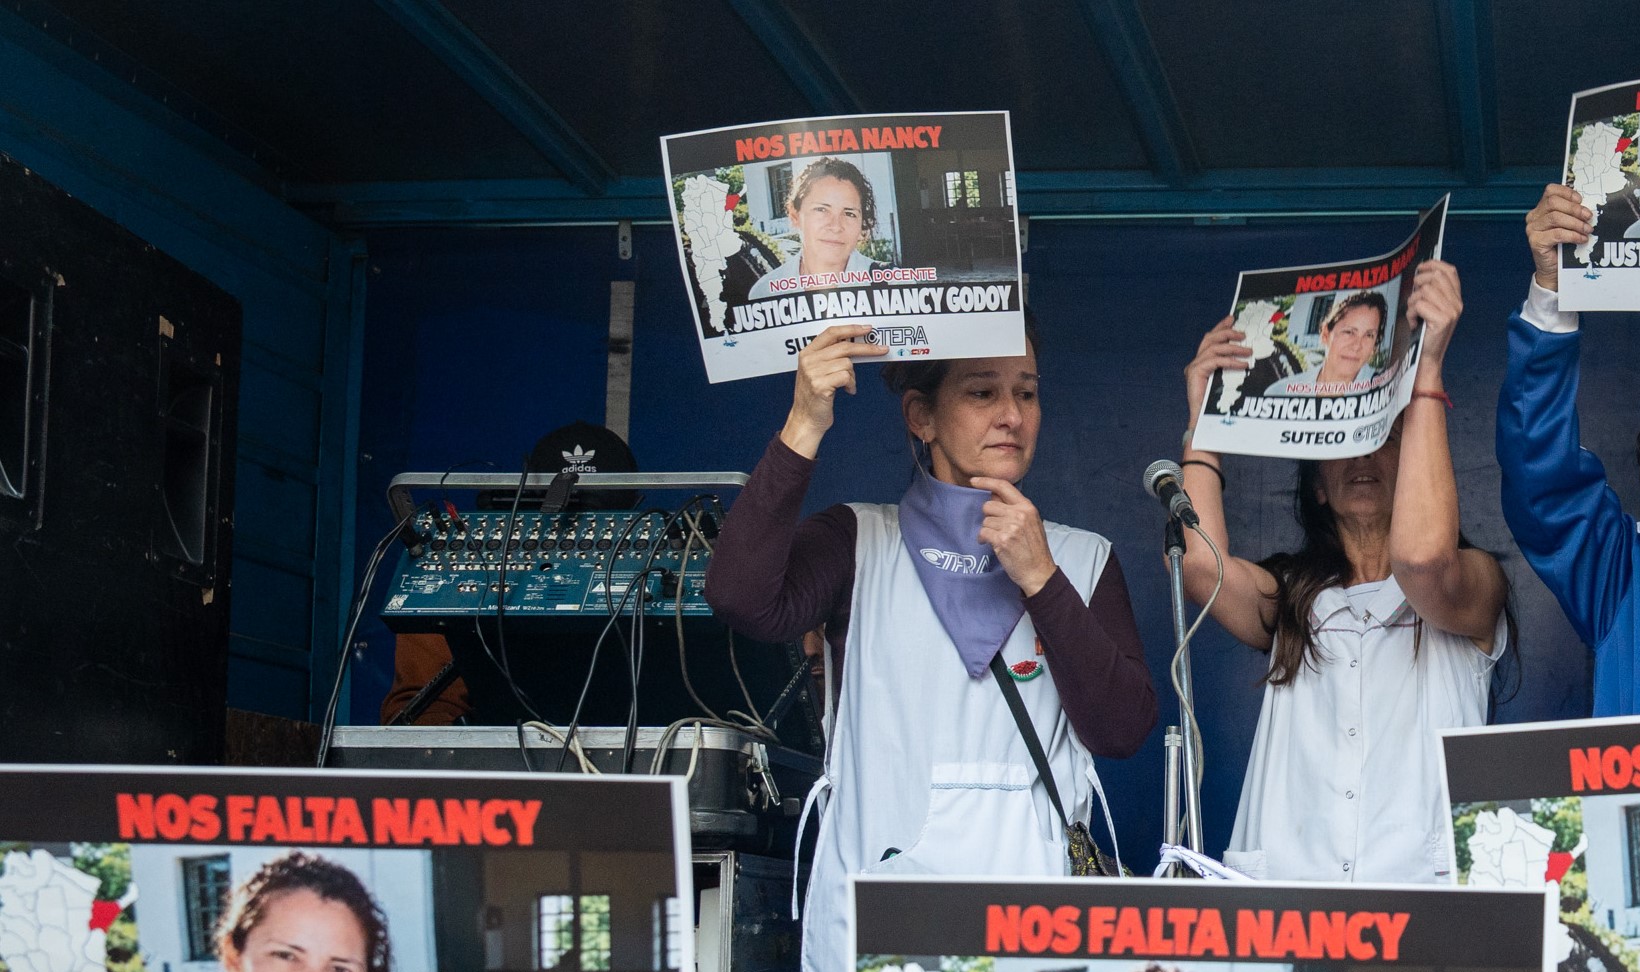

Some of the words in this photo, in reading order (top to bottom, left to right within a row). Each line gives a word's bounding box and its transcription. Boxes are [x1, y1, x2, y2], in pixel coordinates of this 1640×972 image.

[736, 135, 785, 161] NOS
[789, 129, 859, 155] FALTA
[862, 126, 942, 149] NANCY
[770, 278, 797, 292] NOS
[800, 274, 839, 289] FALTA
[841, 271, 869, 284] UNA
[873, 268, 936, 281] DOCENTE
[1295, 275, 1335, 292] NOS
[1340, 264, 1388, 290] FALTA
[732, 296, 814, 333] JUSTICIA
[814, 290, 874, 319] PARA
[872, 286, 945, 314] NANCY
[946, 285, 1011, 312] GODOY
[1287, 383, 1311, 393] NOS
[1314, 383, 1349, 394] FALTA
[1349, 379, 1372, 392] UNA
[1238, 396, 1318, 420] JUSTICIA
[1318, 396, 1355, 420] POR
[1280, 430, 1345, 444] SUTECO
[562, 464, 597, 474] adidas
[116, 793, 221, 841] NOS
[228, 795, 367, 842] FALTA
[373, 800, 543, 846] NANCY
[986, 905, 1082, 954] NOS
[1087, 907, 1230, 957] FALTA
[1236, 910, 1410, 959] NANCY
